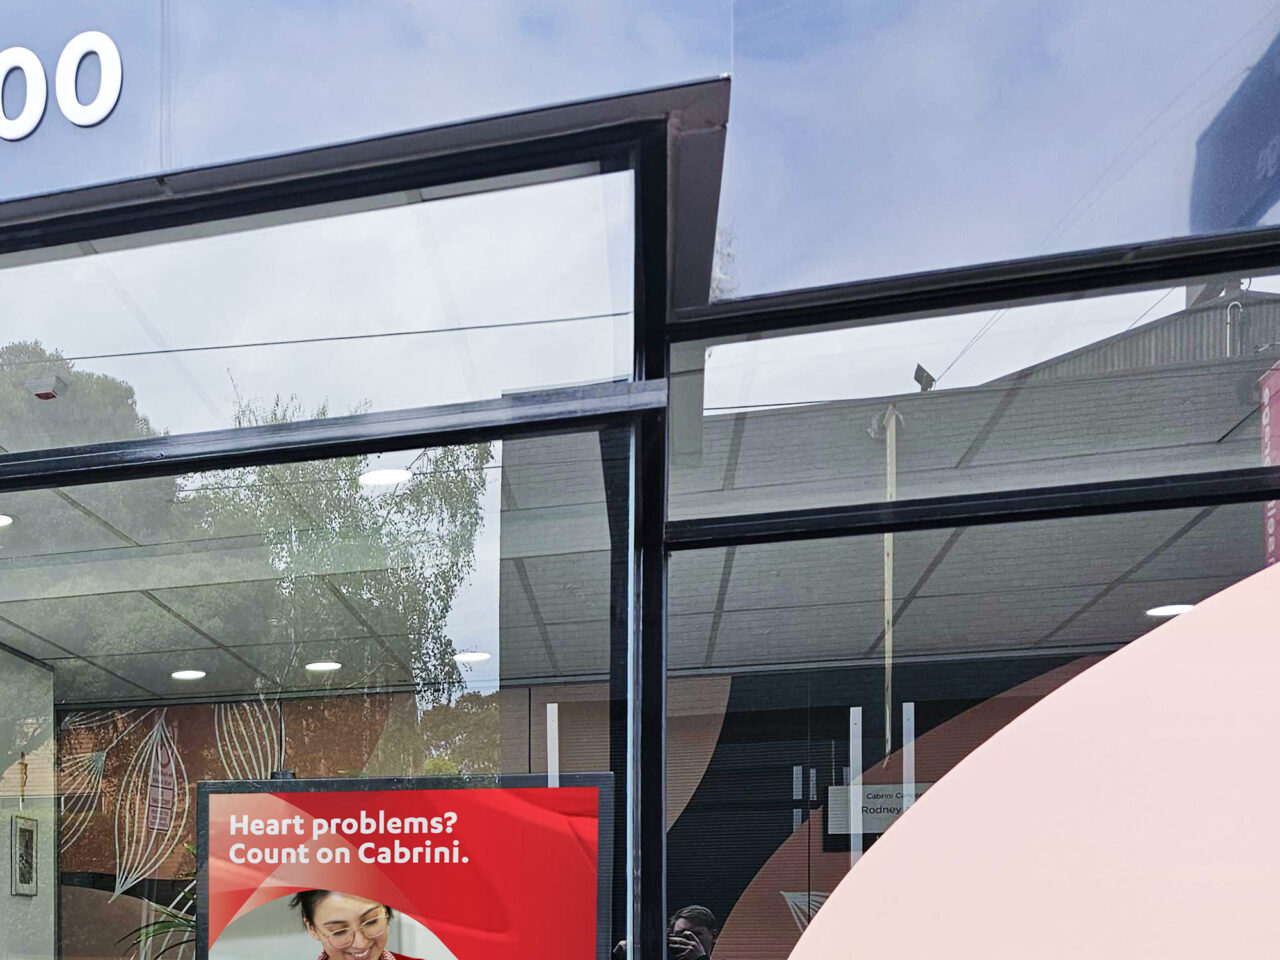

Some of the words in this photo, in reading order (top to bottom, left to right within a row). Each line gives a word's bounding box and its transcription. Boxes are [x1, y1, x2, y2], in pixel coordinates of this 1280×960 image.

[866, 792, 894, 800] Cabrini
[862, 806, 902, 815] Rodney
[229, 814, 305, 836] Heart
[313, 811, 458, 840] problems?
[229, 842, 309, 865] Count
[316, 846, 350, 864] on
[358, 840, 469, 864] Cabrini.
